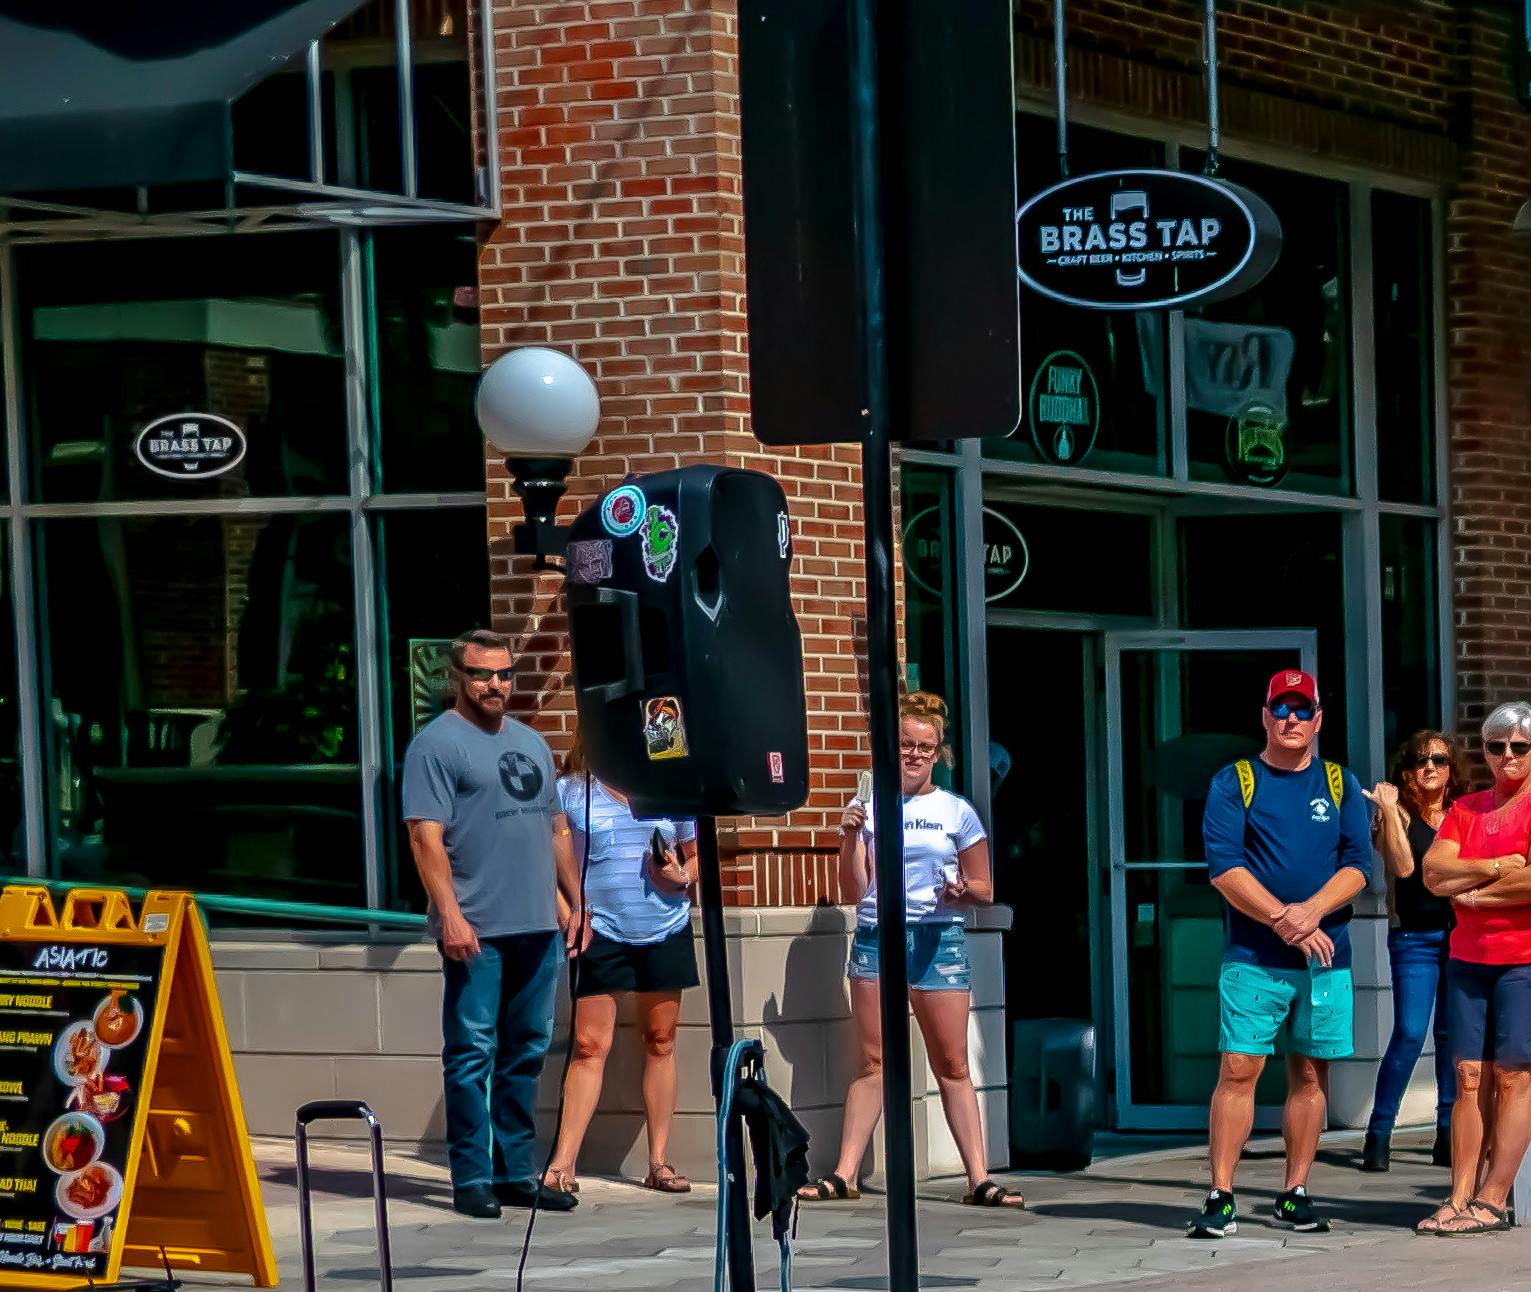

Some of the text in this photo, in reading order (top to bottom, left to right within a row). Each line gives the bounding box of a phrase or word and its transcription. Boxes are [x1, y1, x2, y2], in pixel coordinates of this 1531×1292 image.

[1062, 207, 1094, 221] THE
[1040, 217, 1221, 253] BRASS TAP
[1058, 255, 1088, 266] CRAFT
[1122, 251, 1163, 263] KITCHEN
[1171, 249, 1205, 261] SPIRITS
[149, 437, 232, 453] BRASS TAP
[15, 994, 53, 1009] NOODLE
[15, 1178, 37, 1193] THAI
